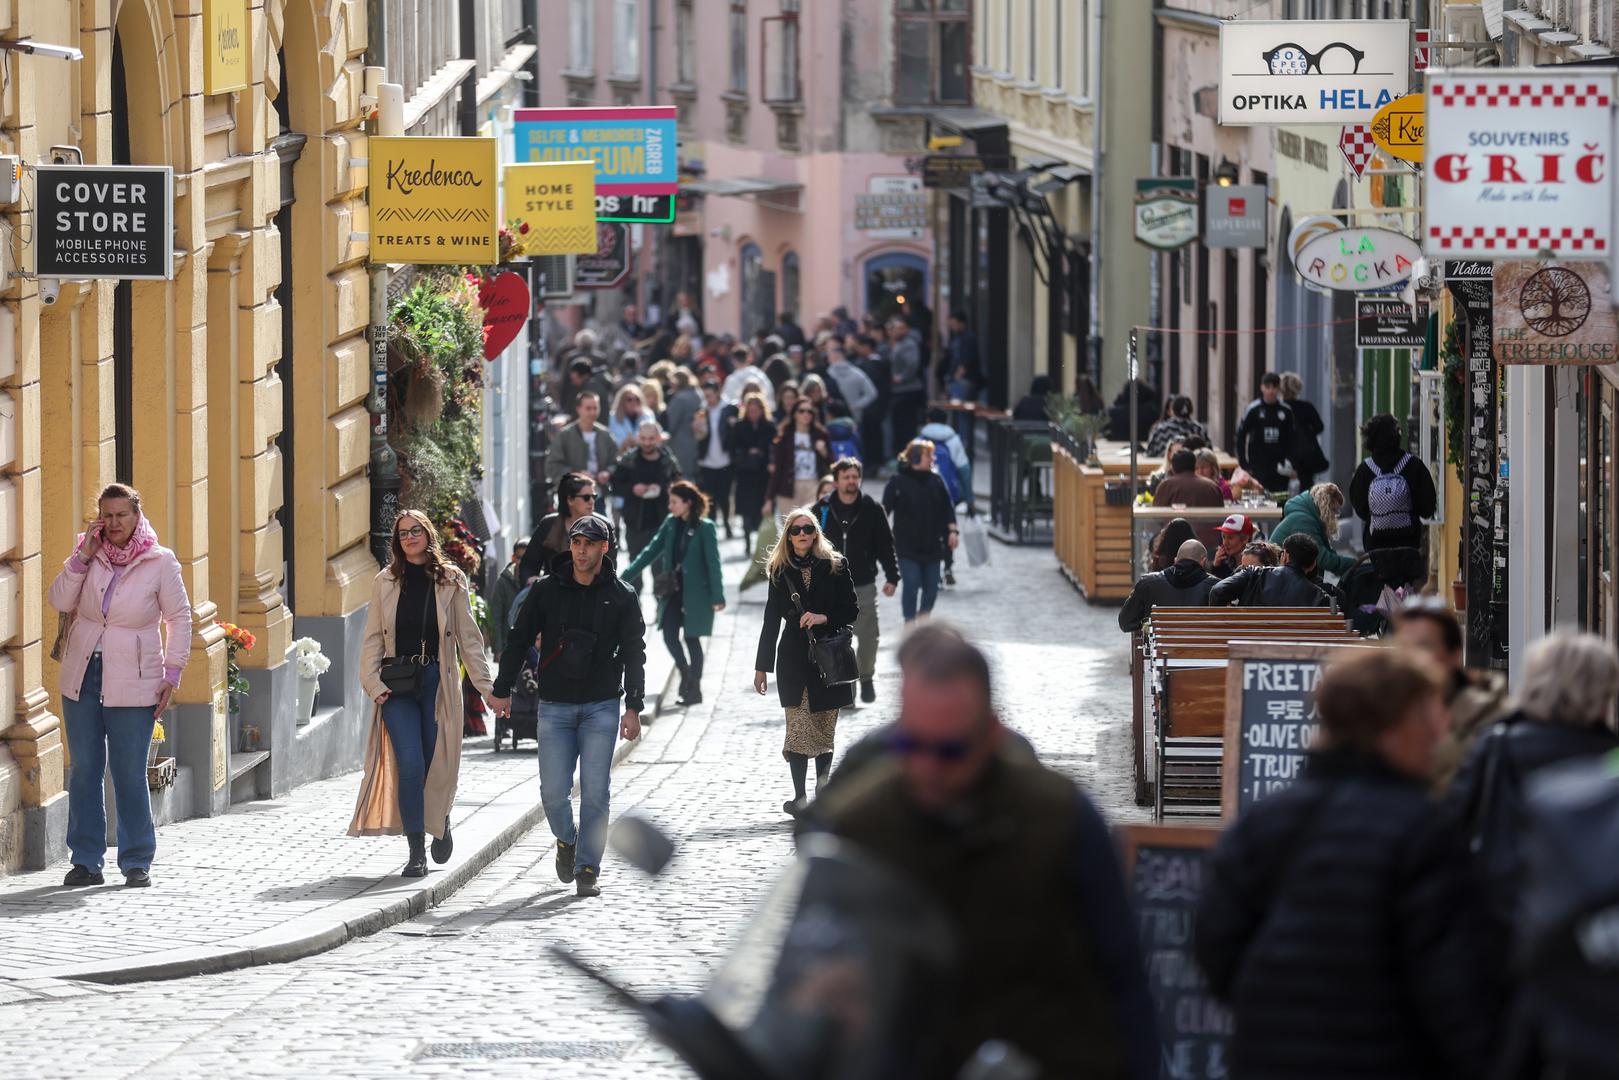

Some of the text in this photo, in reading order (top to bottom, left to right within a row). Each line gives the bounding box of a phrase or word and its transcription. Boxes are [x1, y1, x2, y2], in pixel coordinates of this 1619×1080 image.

[1232, 89, 1392, 110] OPTIKA HELA
[528, 129, 566, 143] SELFIE
[569, 129, 579, 143] &
[1468, 131, 1570, 146] SOUVENIRS
[645, 128, 663, 175] ZAGREB
[530, 146, 645, 175] MUSEUM
[1433, 143, 1605, 184] GRIČ
[386, 158, 483, 195] Kredenca
[56, 182, 146, 204] COVER
[525, 184, 573, 195] HOME
[1476, 187, 1560, 203] Made with love
[525, 200, 574, 211] STYLE
[632, 195, 659, 213] hr
[56, 211, 146, 232] STORE
[55, 239, 147, 250] MOBILE PHONE
[377, 235, 490, 246] TREATS & WINE
[1340, 235, 1375, 255] LA
[55, 253, 147, 264] ACCESSORIES
[1308, 254, 1412, 283] ROCKA
[1401, 336, 1426, 344] SALON
[1498, 327, 1529, 341] THE
[1498, 343, 1614, 360] TREEHOUSE
[1267, 700, 1304, 720] 무료
